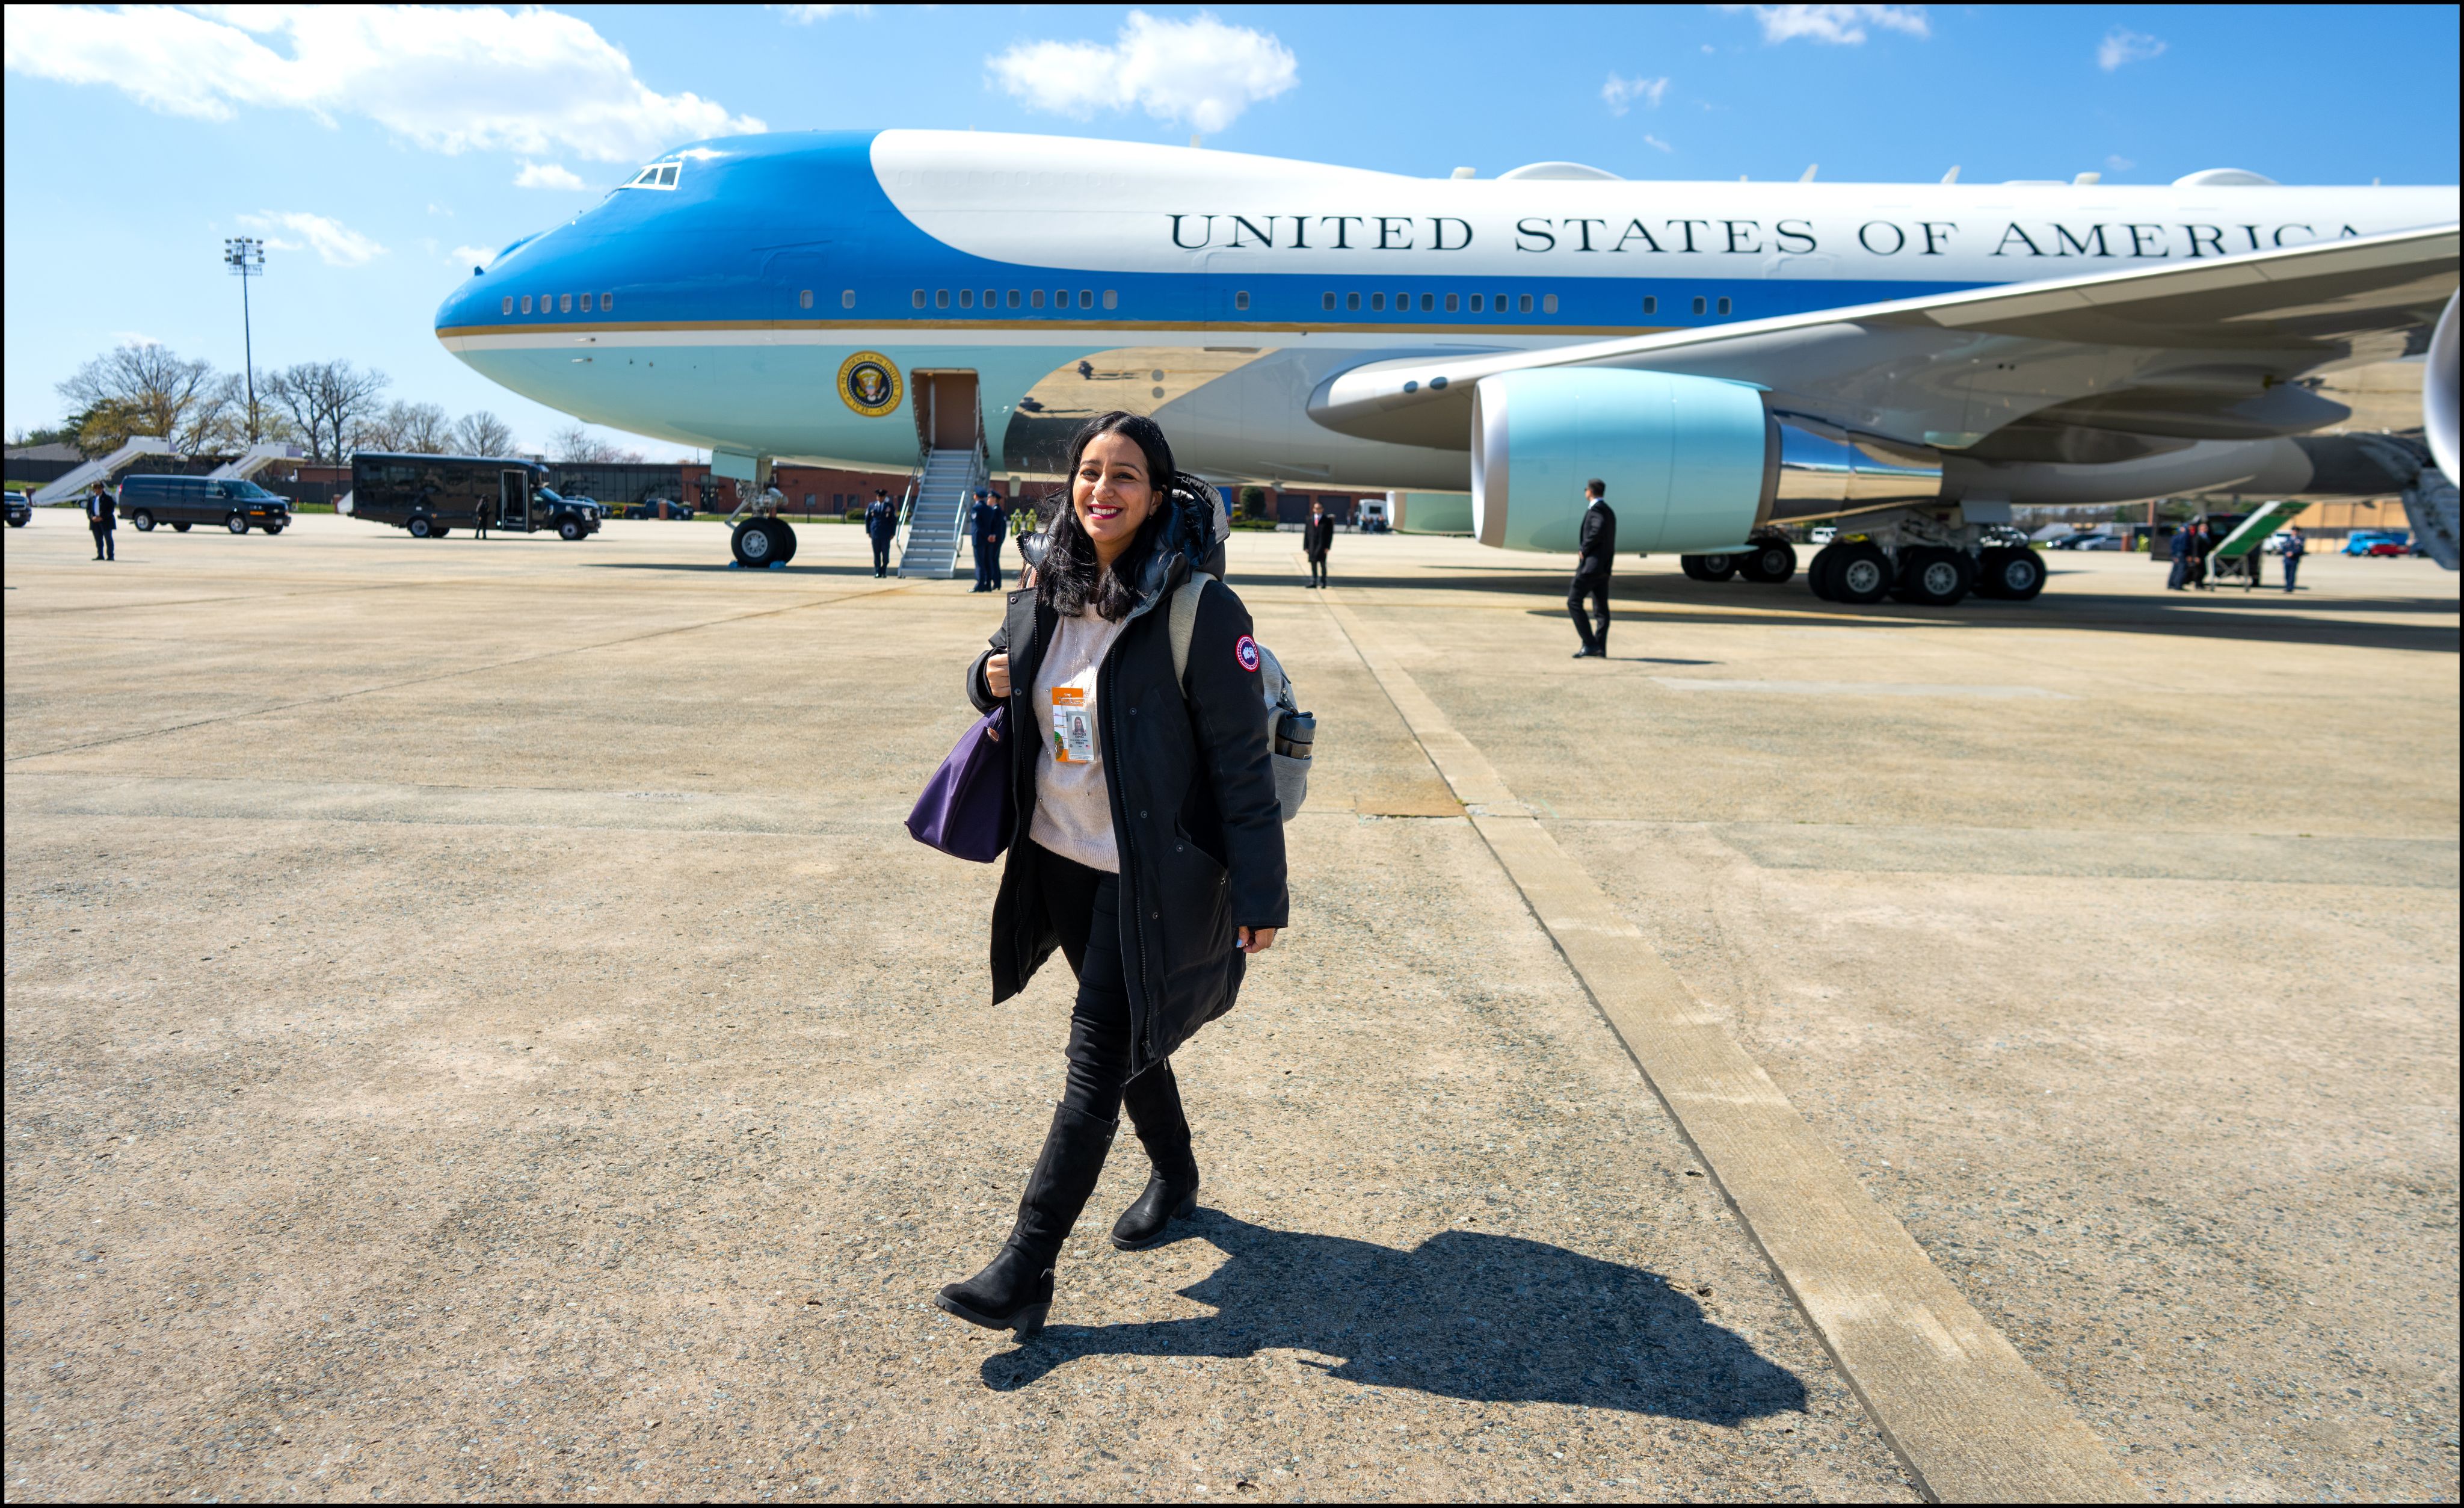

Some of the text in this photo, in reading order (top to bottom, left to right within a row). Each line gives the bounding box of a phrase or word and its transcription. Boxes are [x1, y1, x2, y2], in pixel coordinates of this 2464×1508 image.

[1165, 214, 1473, 250] UNITED
[1515, 217, 1817, 254] STATES
[1858, 220, 1959, 256] OF
[841, 354, 866, 384] PRESIDENT
[884, 361, 900, 391] UNITED
[879, 394, 899, 413] STATES
